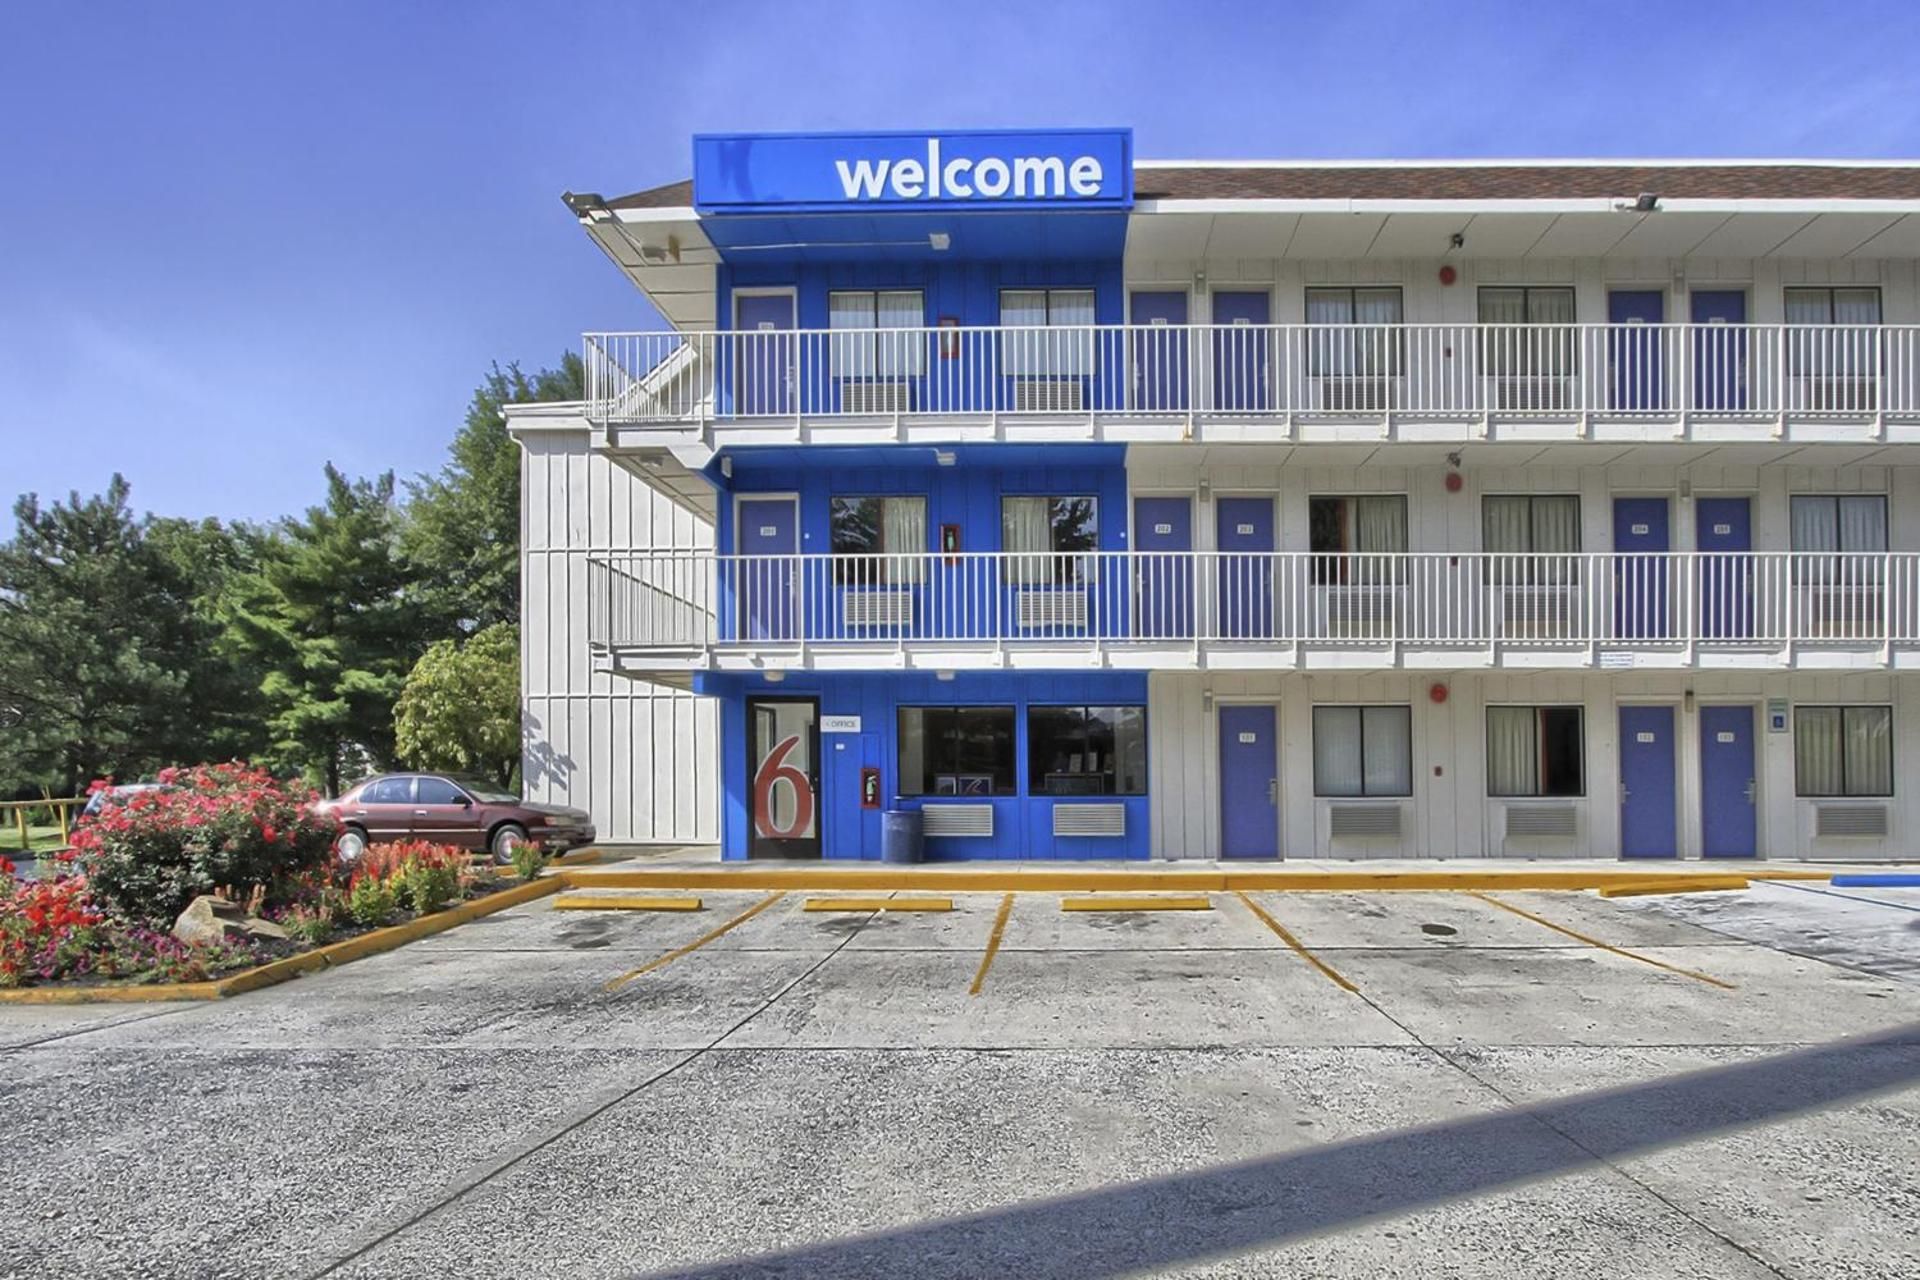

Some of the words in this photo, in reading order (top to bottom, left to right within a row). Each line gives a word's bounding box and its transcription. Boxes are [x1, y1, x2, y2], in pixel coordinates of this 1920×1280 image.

[836, 138, 1103, 199] welcome
[831, 720, 857, 728] OFFICE
[754, 735, 815, 839] 6
